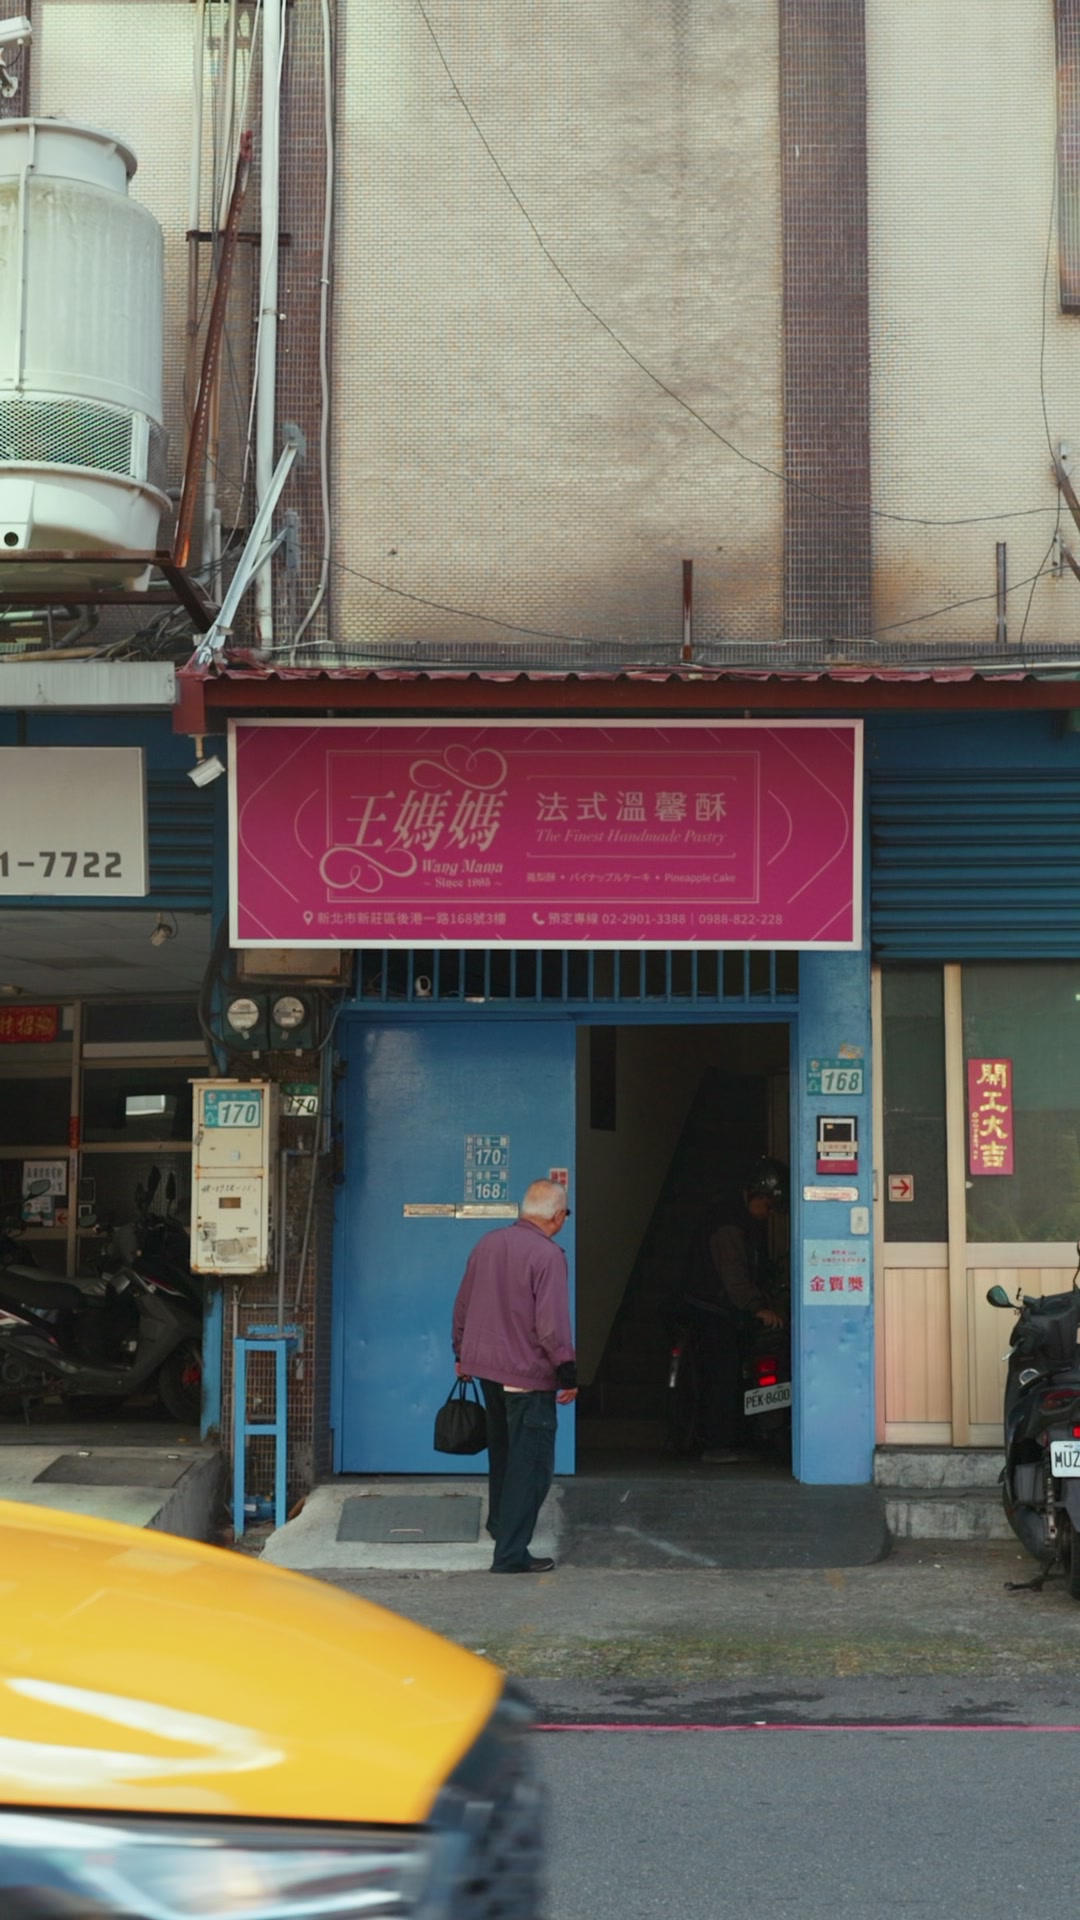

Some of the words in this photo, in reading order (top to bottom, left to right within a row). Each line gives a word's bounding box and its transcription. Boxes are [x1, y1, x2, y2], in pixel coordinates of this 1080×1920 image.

[535, 791, 727, 822] 法式溫馨酥
[333, 789, 507, 852] 王媽媽
[535, 828, 560, 842] The
[564, 828, 604, 842] Finest
[607, 828, 682, 843] Handmade
[684, 828, 728, 846] Pastry
[422, 859, 458, 876] Wang
[461, 859, 504, 874] Mama
[434, 877, 464, 888] Since
[664, 872, 711, 885] Pineapple
[713, 872, 736, 883] Cake
[602, 912, 686, 925] 02-2901-3388
[699, 912, 783, 925] 0988-822-228
[825, 1072, 860, 1091] 168
[222, 1104, 257, 1124] 170
[976, 1063, 1008, 1168] 開工大吉
[476, 1149, 501, 1165] 170
[476, 1183, 501, 1199] 168
[1054, 1451, 1080, 1468] MUZ
